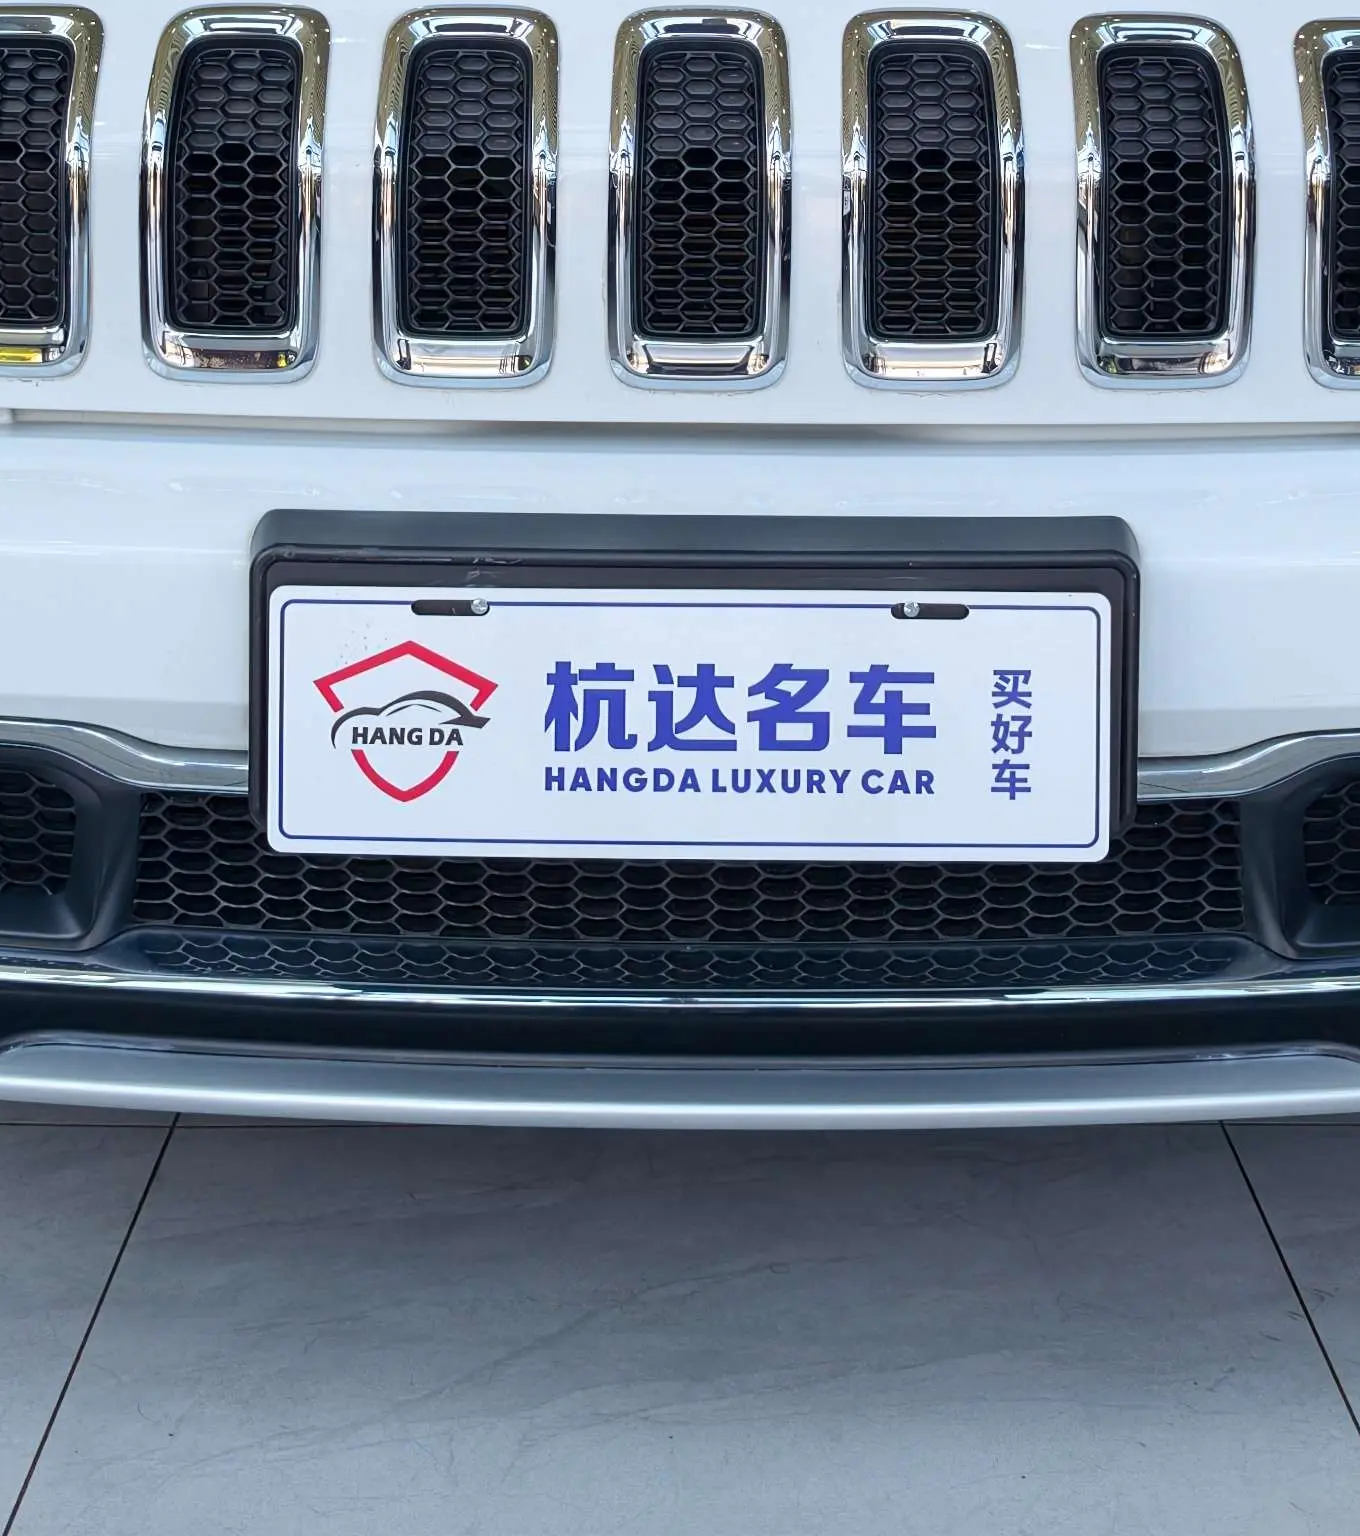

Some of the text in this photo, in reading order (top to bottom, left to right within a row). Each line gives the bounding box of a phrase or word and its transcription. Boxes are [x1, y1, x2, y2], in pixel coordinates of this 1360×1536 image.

[350, 725, 464, 748] HANG DA
[544, 660, 938, 756] 杭达名车
[990, 668, 1033, 801] 买好车
[544, 765, 935, 796] HANGDA LUXURY CAR
